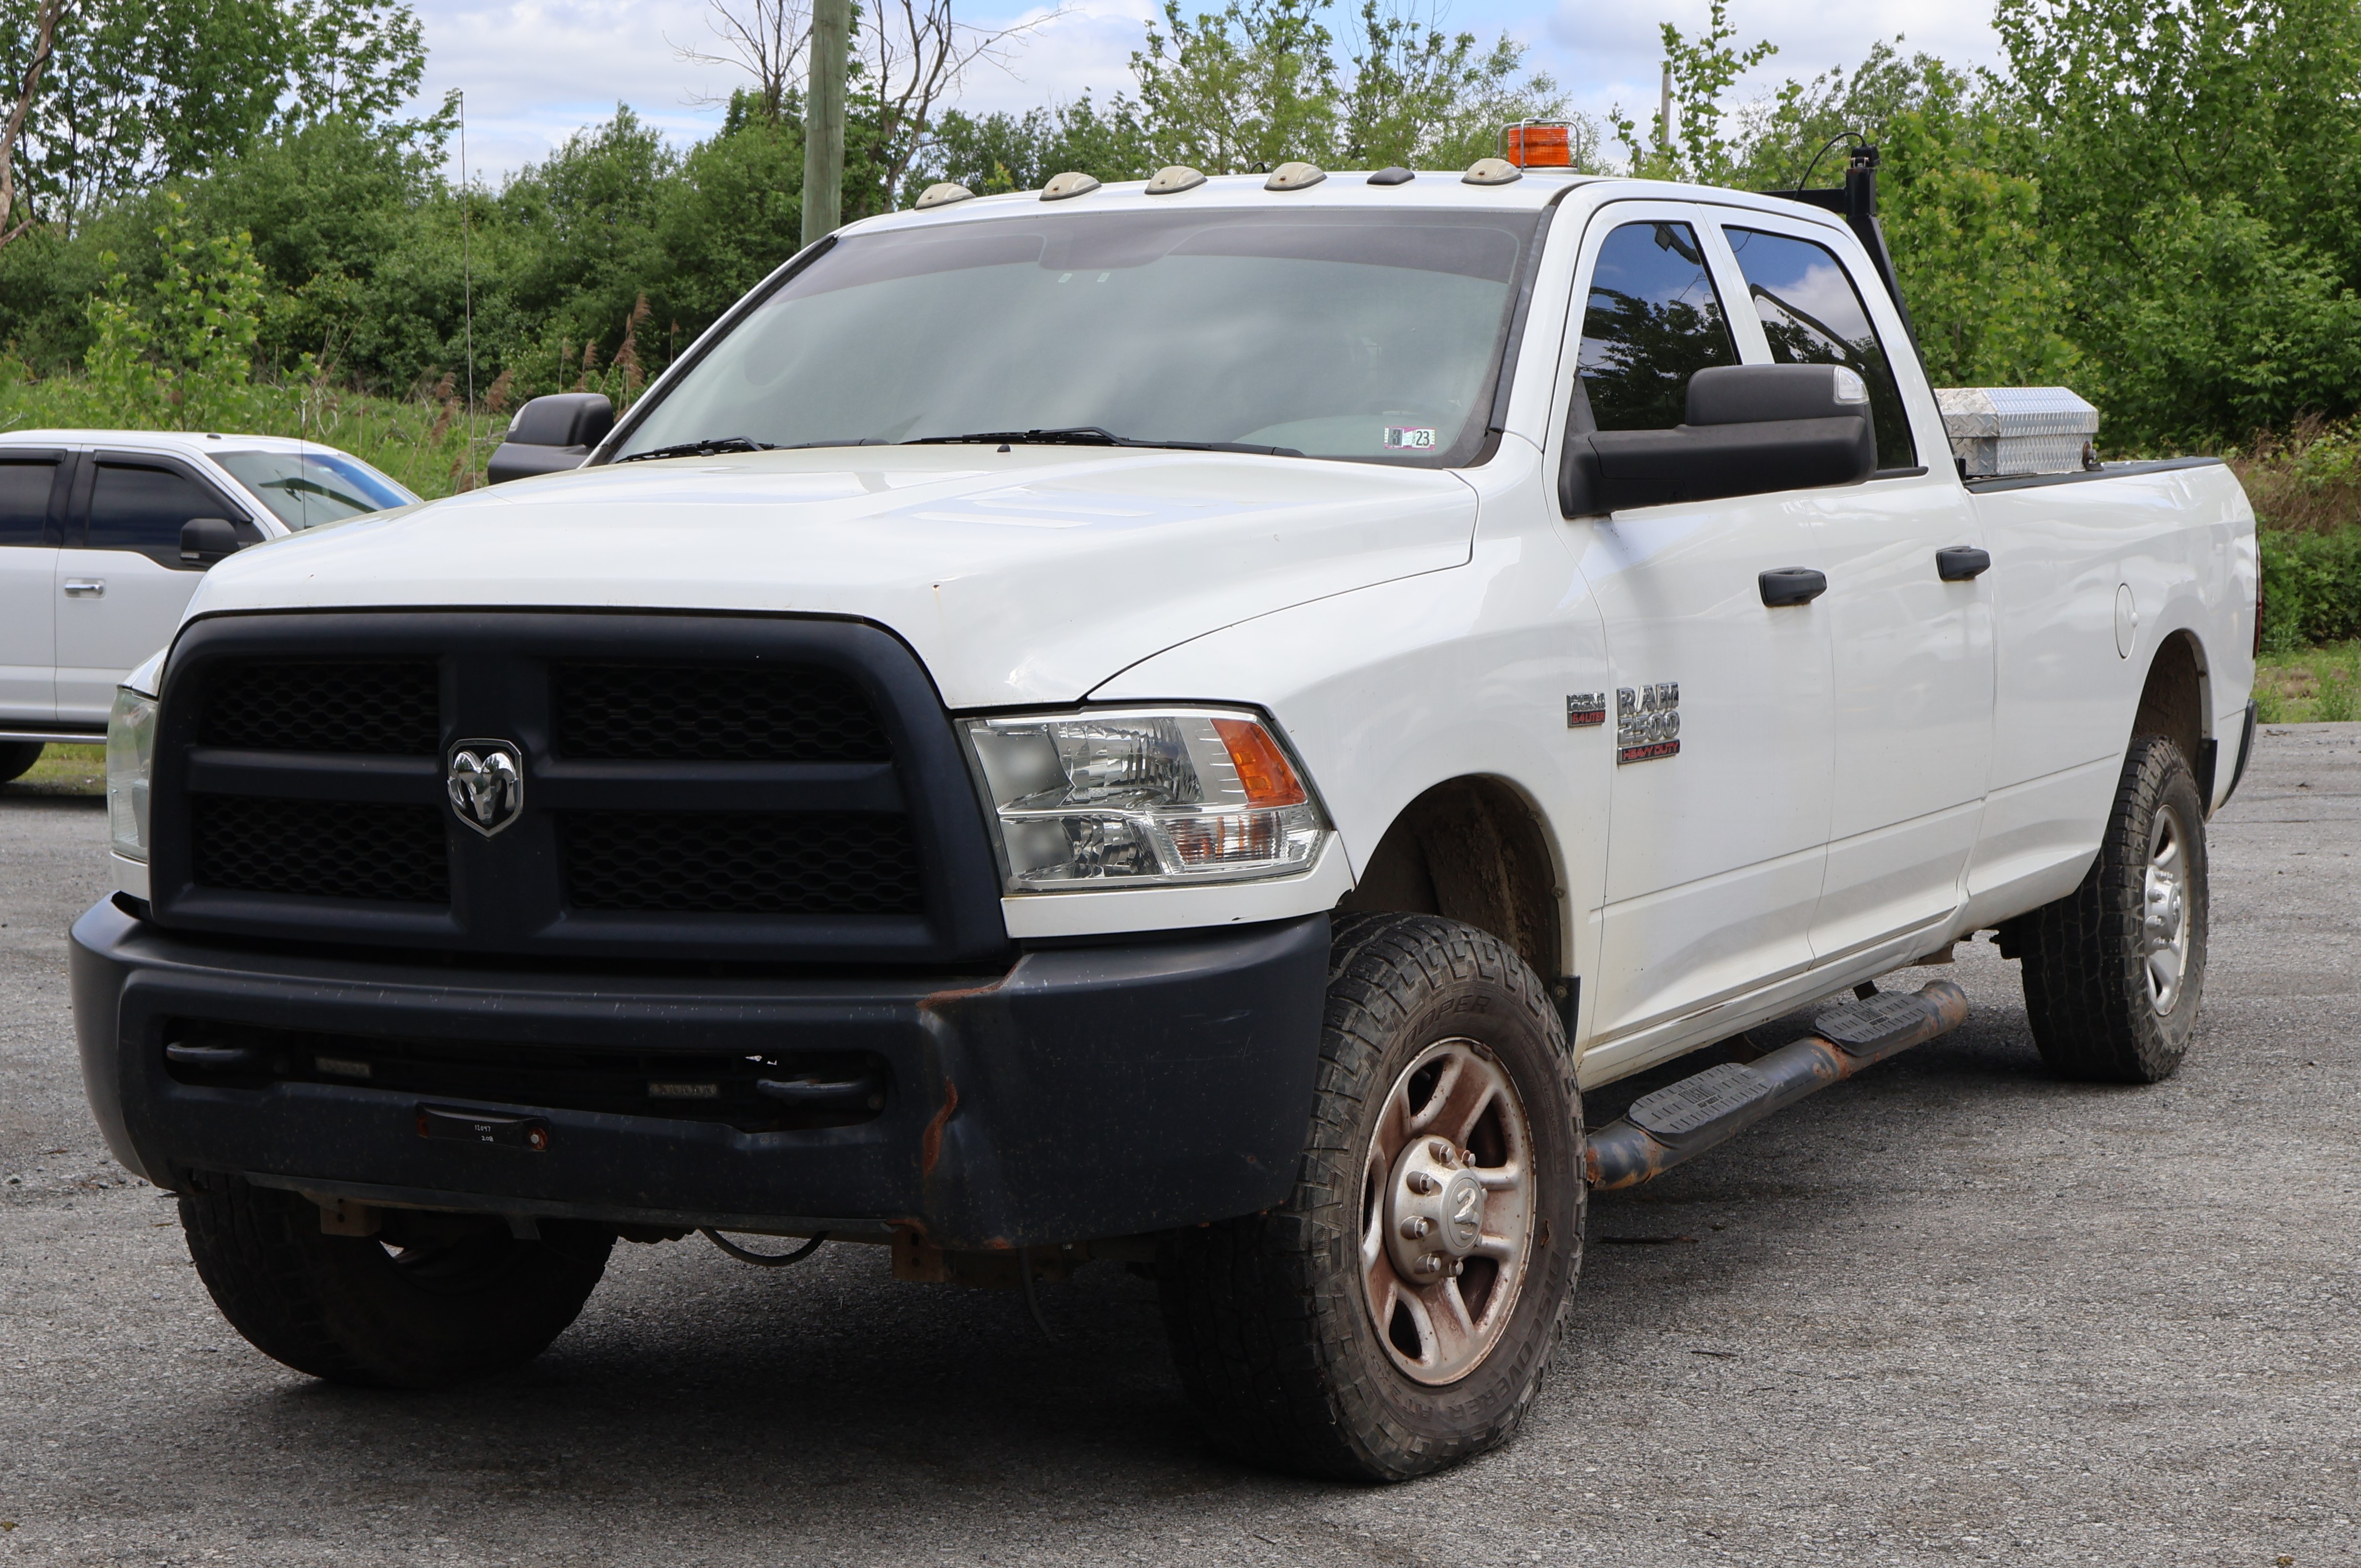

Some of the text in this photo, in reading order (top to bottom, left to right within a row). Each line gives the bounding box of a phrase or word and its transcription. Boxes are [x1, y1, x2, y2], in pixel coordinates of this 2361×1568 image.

[1392, 429, 1401, 445] 3
[1415, 431, 1430, 446] 23
[1617, 682, 1679, 715] RAM
[1618, 710, 1680, 745] 2500
[1623, 742, 1678, 760] HEAVY DUTY
[1386, 994, 1492, 1082] COOPER
[1447, 1250, 1562, 1423] DISCOVERER
